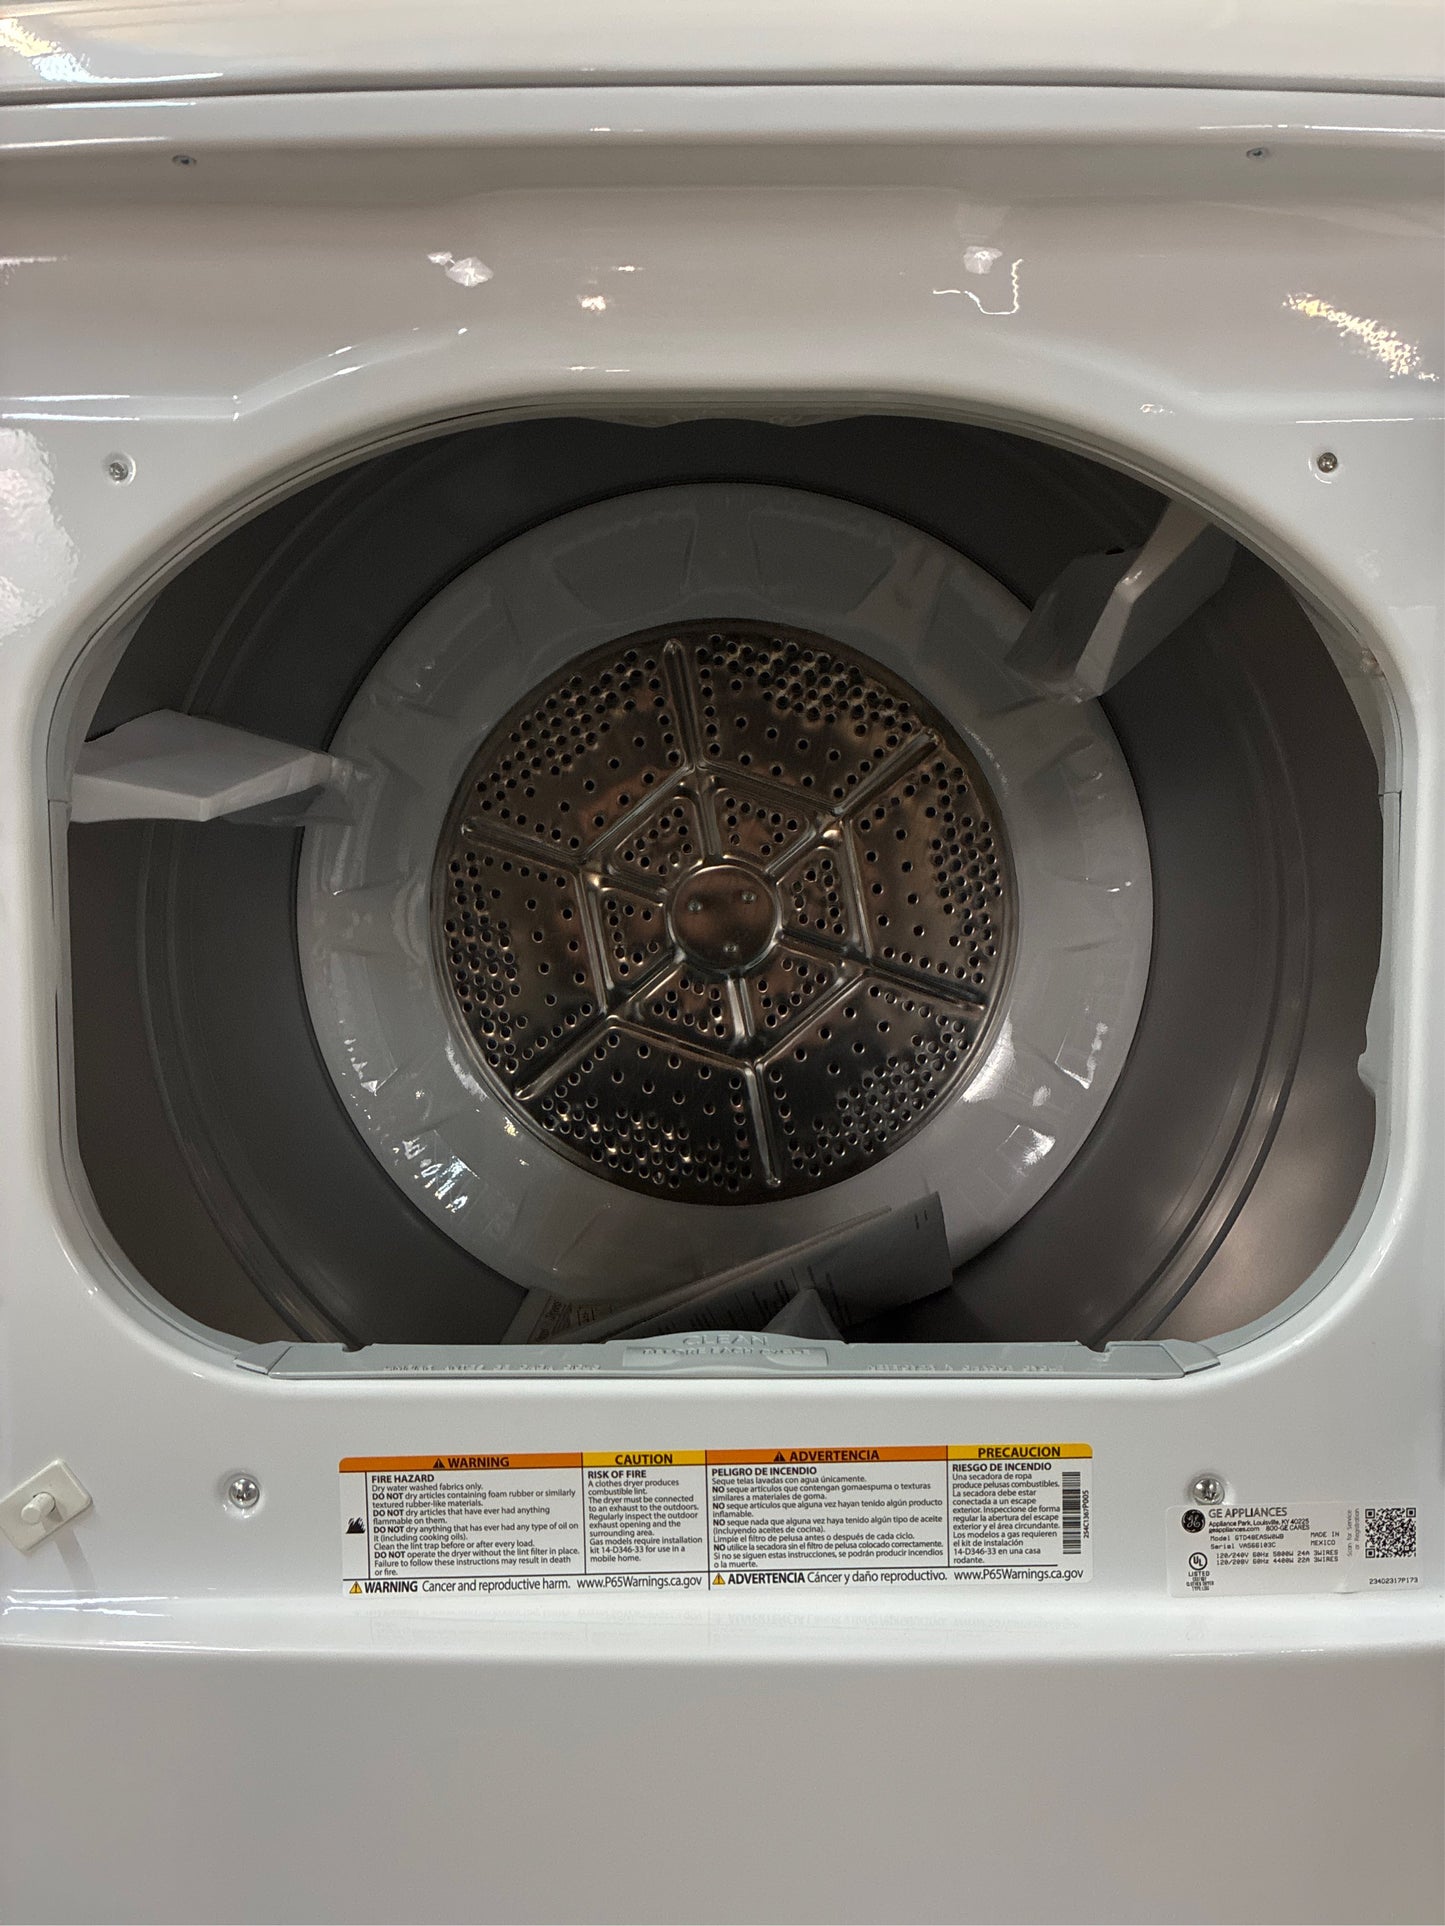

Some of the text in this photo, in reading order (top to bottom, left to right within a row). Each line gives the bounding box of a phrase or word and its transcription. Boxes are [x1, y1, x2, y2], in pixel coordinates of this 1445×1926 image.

[683, 1334, 768, 1346] CLEAN
[790, 1450, 879, 1462] ADVERTENCIA
[978, 1447, 1060, 1458] PRECAUCION
[448, 1456, 509, 1468] WARNING
[615, 1454, 673, 1465] CAUTION
[712, 1468, 753, 1476] PELIGRO
[770, 1467, 817, 1475] INCENDIO
[953, 1464, 988, 1472] RIESGO
[1004, 1463, 1052, 1471] INCENDIO
[372, 1474, 434, 1483] FIRE HAZARD
[611, 1470, 624, 1478] OF
[626, 1470, 647, 1478] FIRE
[953, 1472, 968, 1480] Una
[969, 1472, 1003, 1480] secadora
[1015, 1473, 1032, 1481] ropa
[588, 1478, 679, 1488] A clothes dryer produces
[712, 1477, 736, 1486] Seque
[736, 1476, 754, 1484] telas
[800, 1477, 819, 1485] agua
[820, 1474, 866, 1482] únicamente.
[953, 1481, 982, 1490] produce
[983, 1480, 1010, 1490] pelusas
[372, 1484, 386, 1493] Dry
[439, 1482, 464, 1490] fabrics
[465, 1482, 483, 1491] only.
[588, 1487, 633, 1495] combustible
[712, 1485, 725, 1493] NO
[750, 1484, 782, 1492] artículos
[799, 1484, 840, 1493] contengan
[841, 1484, 893, 1492] gomaespuma
[372, 1492, 385, 1500] DO
[405, 1491, 418, 1501] dry
[419, 1491, 446, 1499] articles
[447, 1490, 487, 1500] containing
[509, 1489, 534, 1497] rubber
[545, 1488, 576, 1498] similarly
[953, 1504, 1060, 1515] exterior. Inspeccione de forma
[1082, 1490, 1090, 1539] 254C1367P005
[1209, 1507, 1288, 1518] GE APPLIANCES
[589, 1512, 624, 1522] Regularly
[625, 1512, 652, 1521] inspect
[653, 1511, 666, 1519] the
[953, 1514, 979, 1523] regular
[988, 1513, 1020, 1521] abertura
[589, 1529, 635, 1539] surrounding
[605, 1537, 632, 1545] models
[634, 1536, 660, 1546] require
[662, 1536, 703, 1544] installation
[714, 1543, 726, 1551] NO
[727, 1543, 748, 1551] utilice
[756, 1542, 787, 1550] secadora
[788, 1542, 798, 1550] sin
[799, 1542, 806, 1550] el
[834, 1541, 858, 1551] pelusa
[388, 1550, 405, 1558] NOT
[407, 1551, 436, 1559] operate
[437, 1549, 450, 1557] the
[451, 1549, 471, 1559] dryer
[472, 1548, 502, 1556] without
[503, 1548, 516, 1556] the
[530, 1547, 548, 1555] filter
[549, 1547, 557, 1555] in
[558, 1547, 579, 1556] place.
[1193, 1556, 1203, 1566] UL
[728, 1569, 1083, 1585] ADVERTENCIA Cáncer y daño reproductivo. www.P65Warnings.ca.gov
[365, 1576, 702, 1592] WARNING Cancer and reproductive harm. www.P65Warnings.ca.gov
